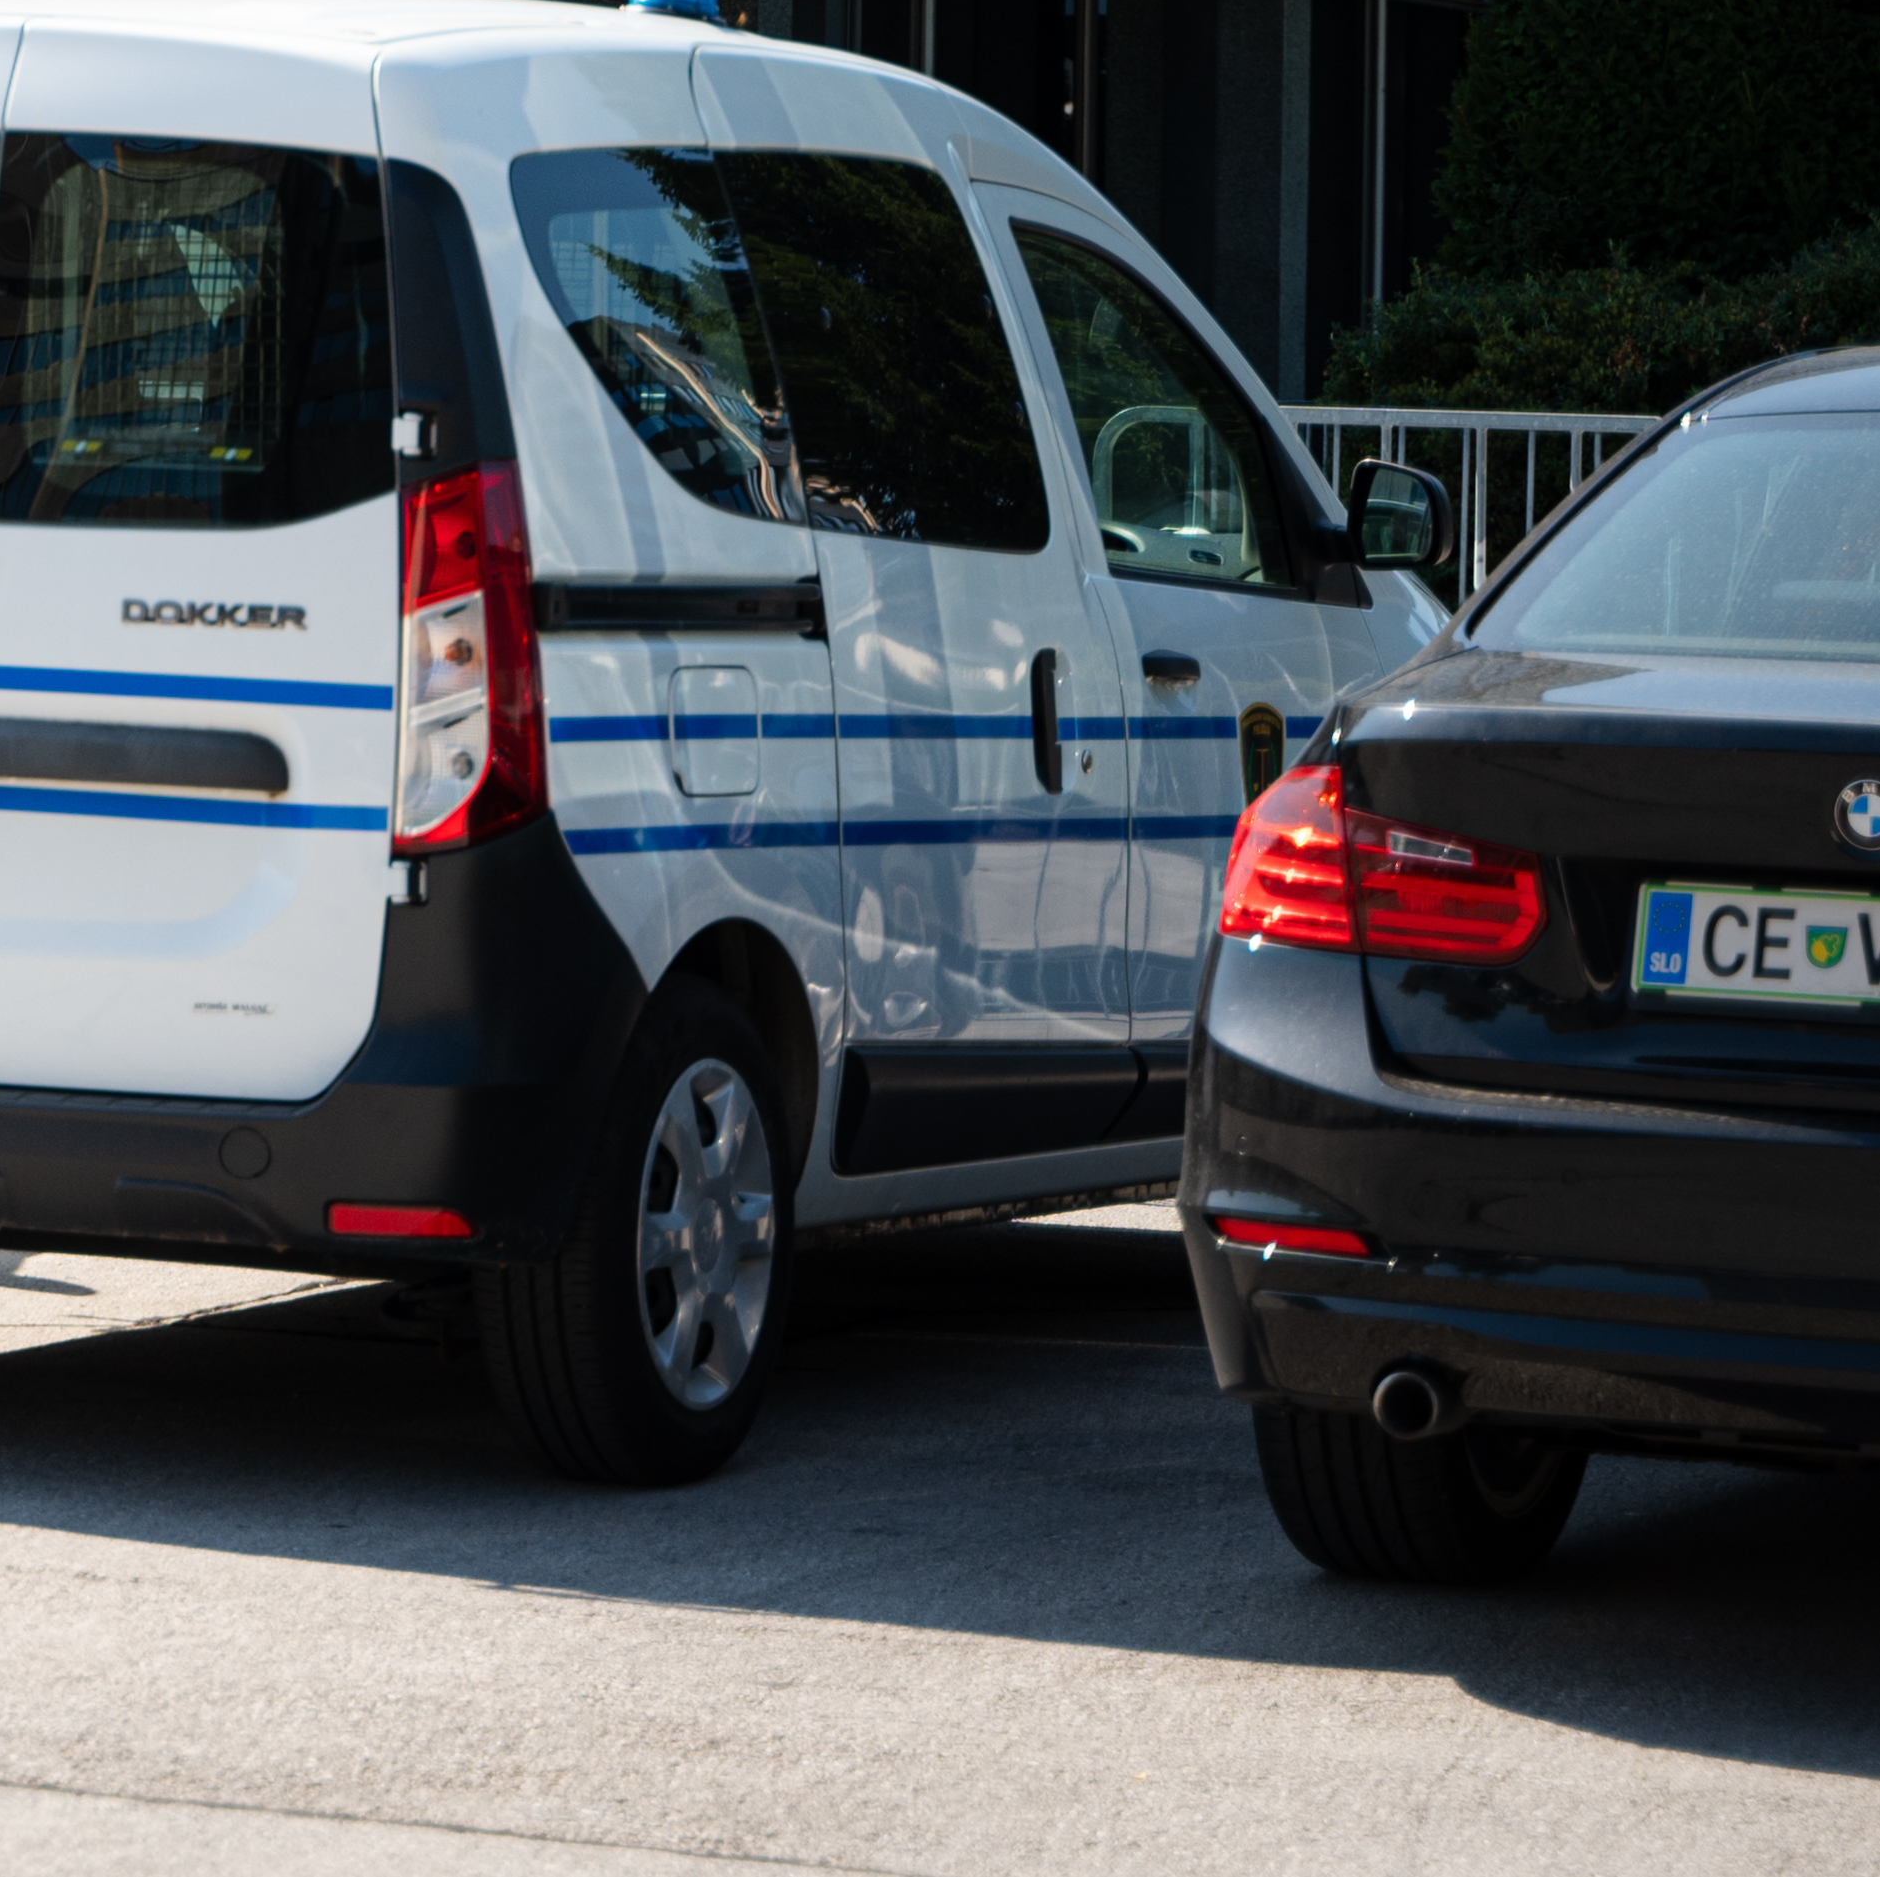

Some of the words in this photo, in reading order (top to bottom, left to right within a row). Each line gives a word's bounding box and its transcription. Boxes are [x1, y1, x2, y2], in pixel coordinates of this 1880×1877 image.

[121, 598, 308, 631] DOKKER
[1702, 904, 1795, 980] CE
[1650, 952, 1682, 973] SLO
